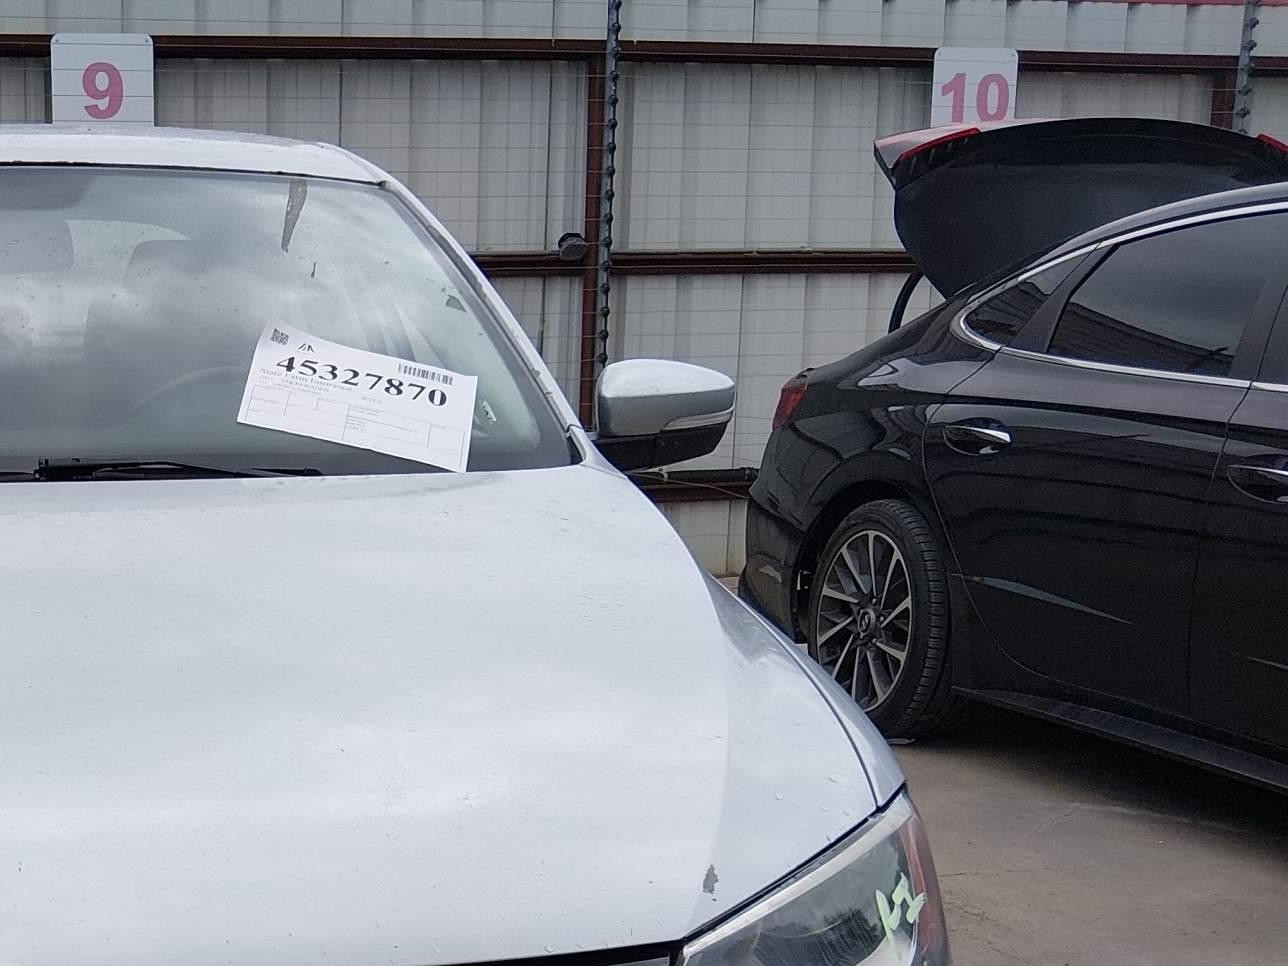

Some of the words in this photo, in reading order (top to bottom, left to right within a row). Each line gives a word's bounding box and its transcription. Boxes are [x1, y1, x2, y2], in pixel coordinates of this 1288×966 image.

[83, 62, 123, 119] 9
[941, 73, 1009, 122] 10
[275, 356, 447, 406] 45327870
